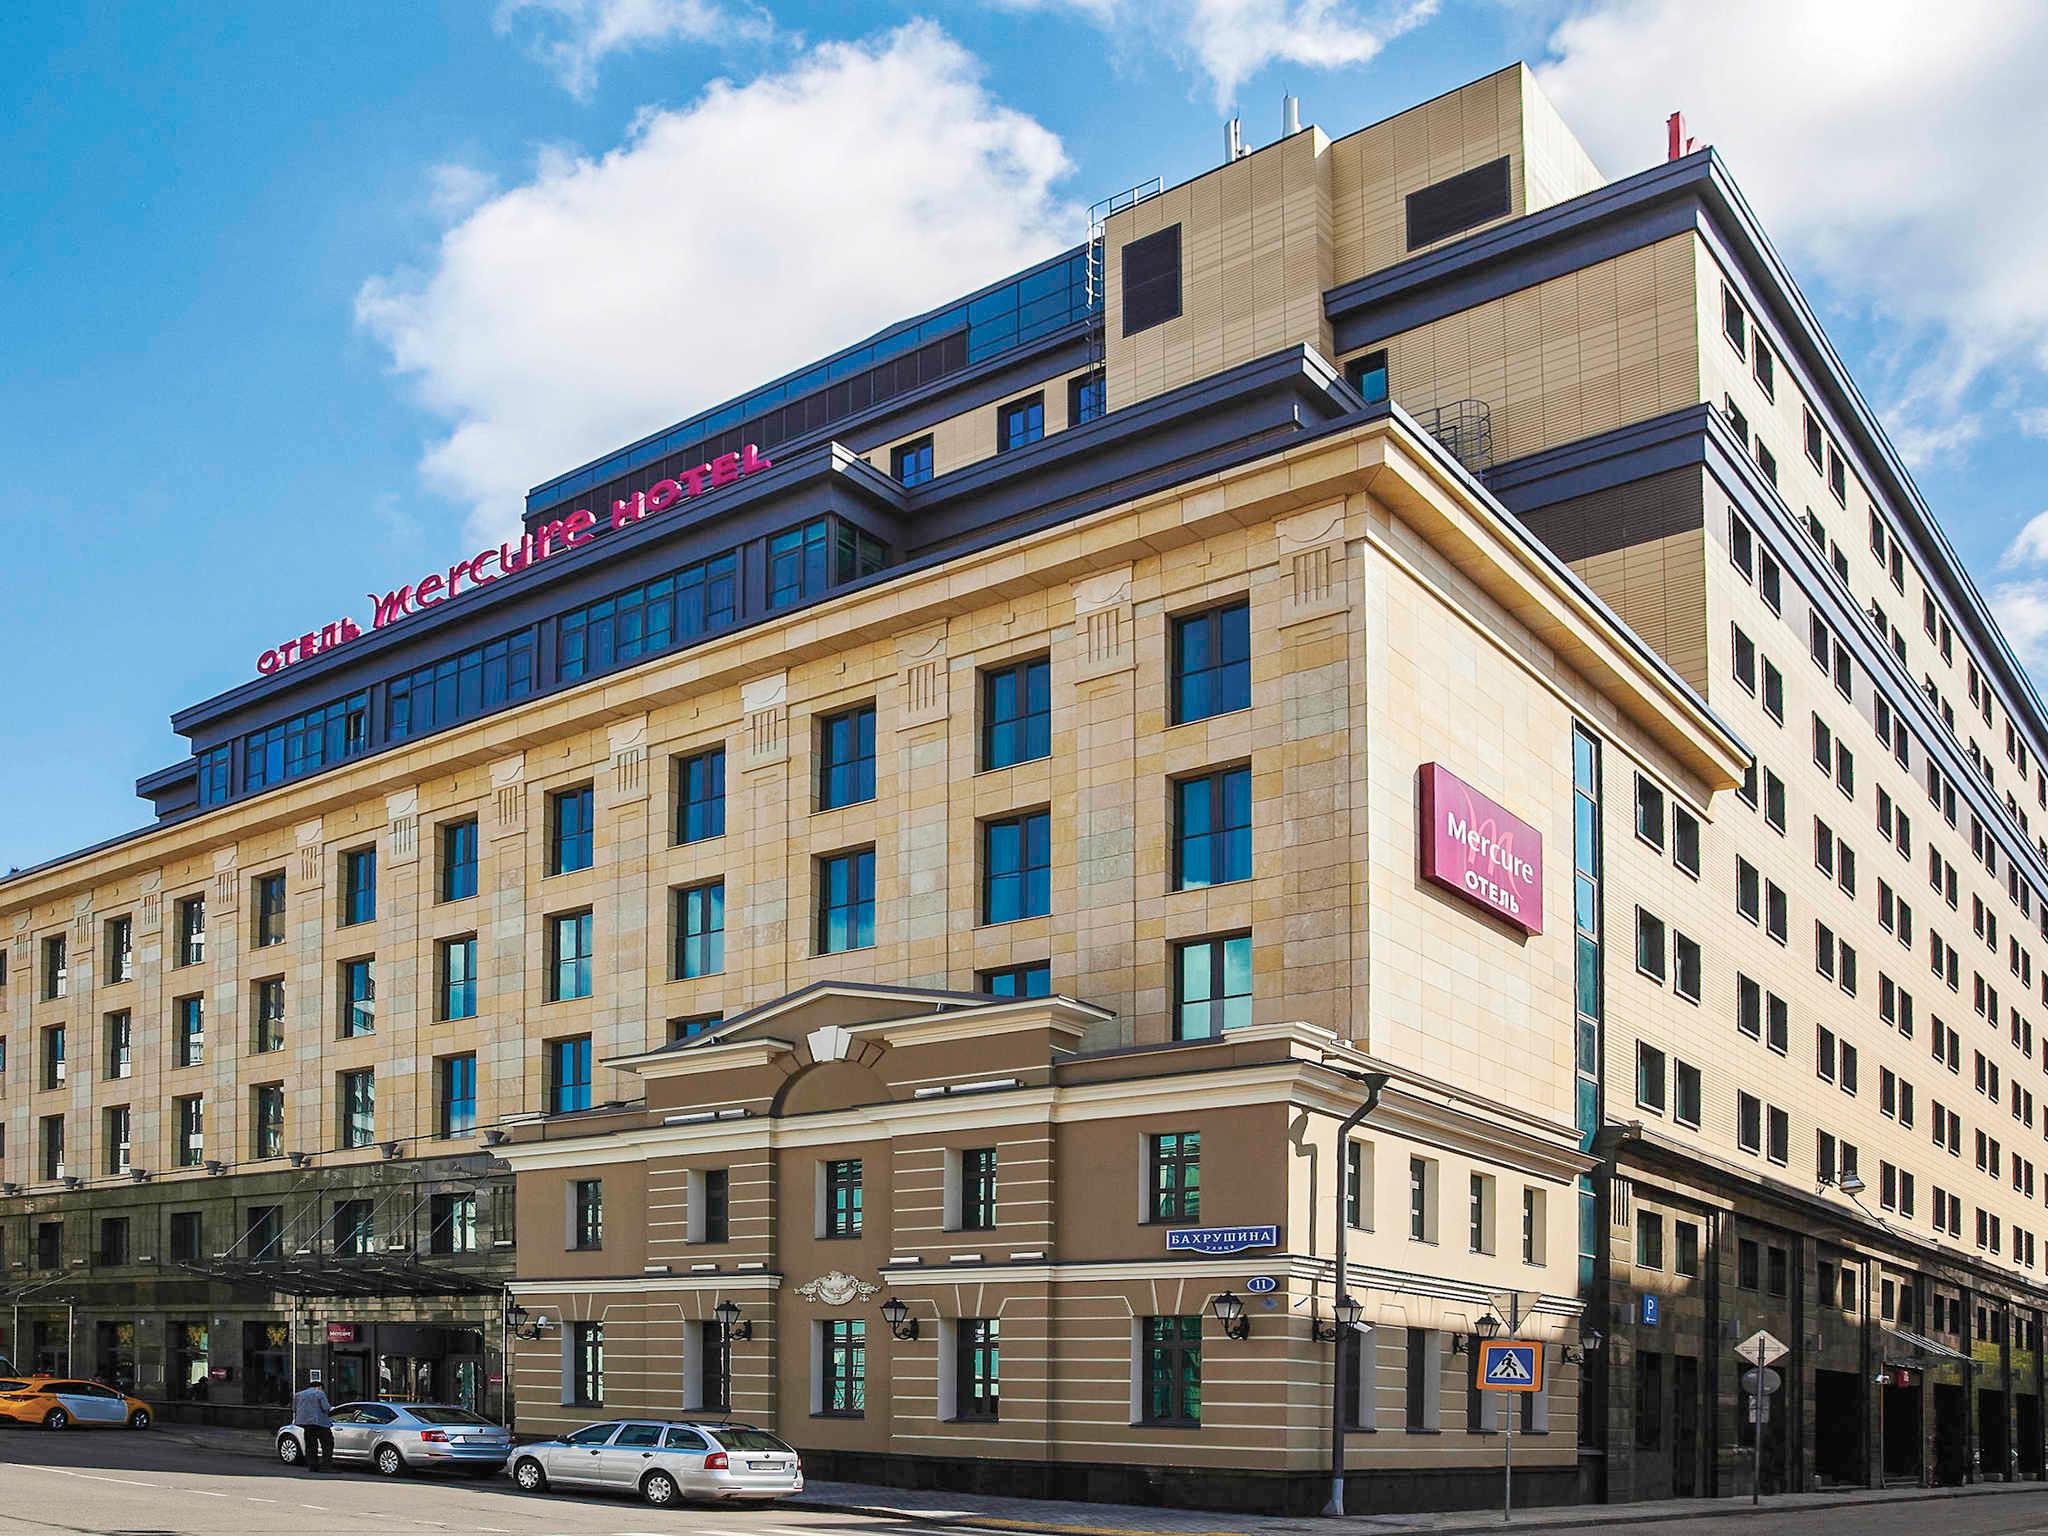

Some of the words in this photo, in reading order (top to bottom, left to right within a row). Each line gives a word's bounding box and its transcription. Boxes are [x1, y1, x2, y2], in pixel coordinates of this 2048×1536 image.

[257, 617, 361, 675] ОТЕЛЬ
[611, 443, 773, 530] HOTEL
[1448, 812, 1534, 884] Mercure
[1464, 870, 1519, 914] ОТЕЛЬ
[1172, 1231, 1271, 1244] БАХРУШИНА
[1255, 1280, 1266, 1290] 11
[1647, 1299, 1654, 1315] P
